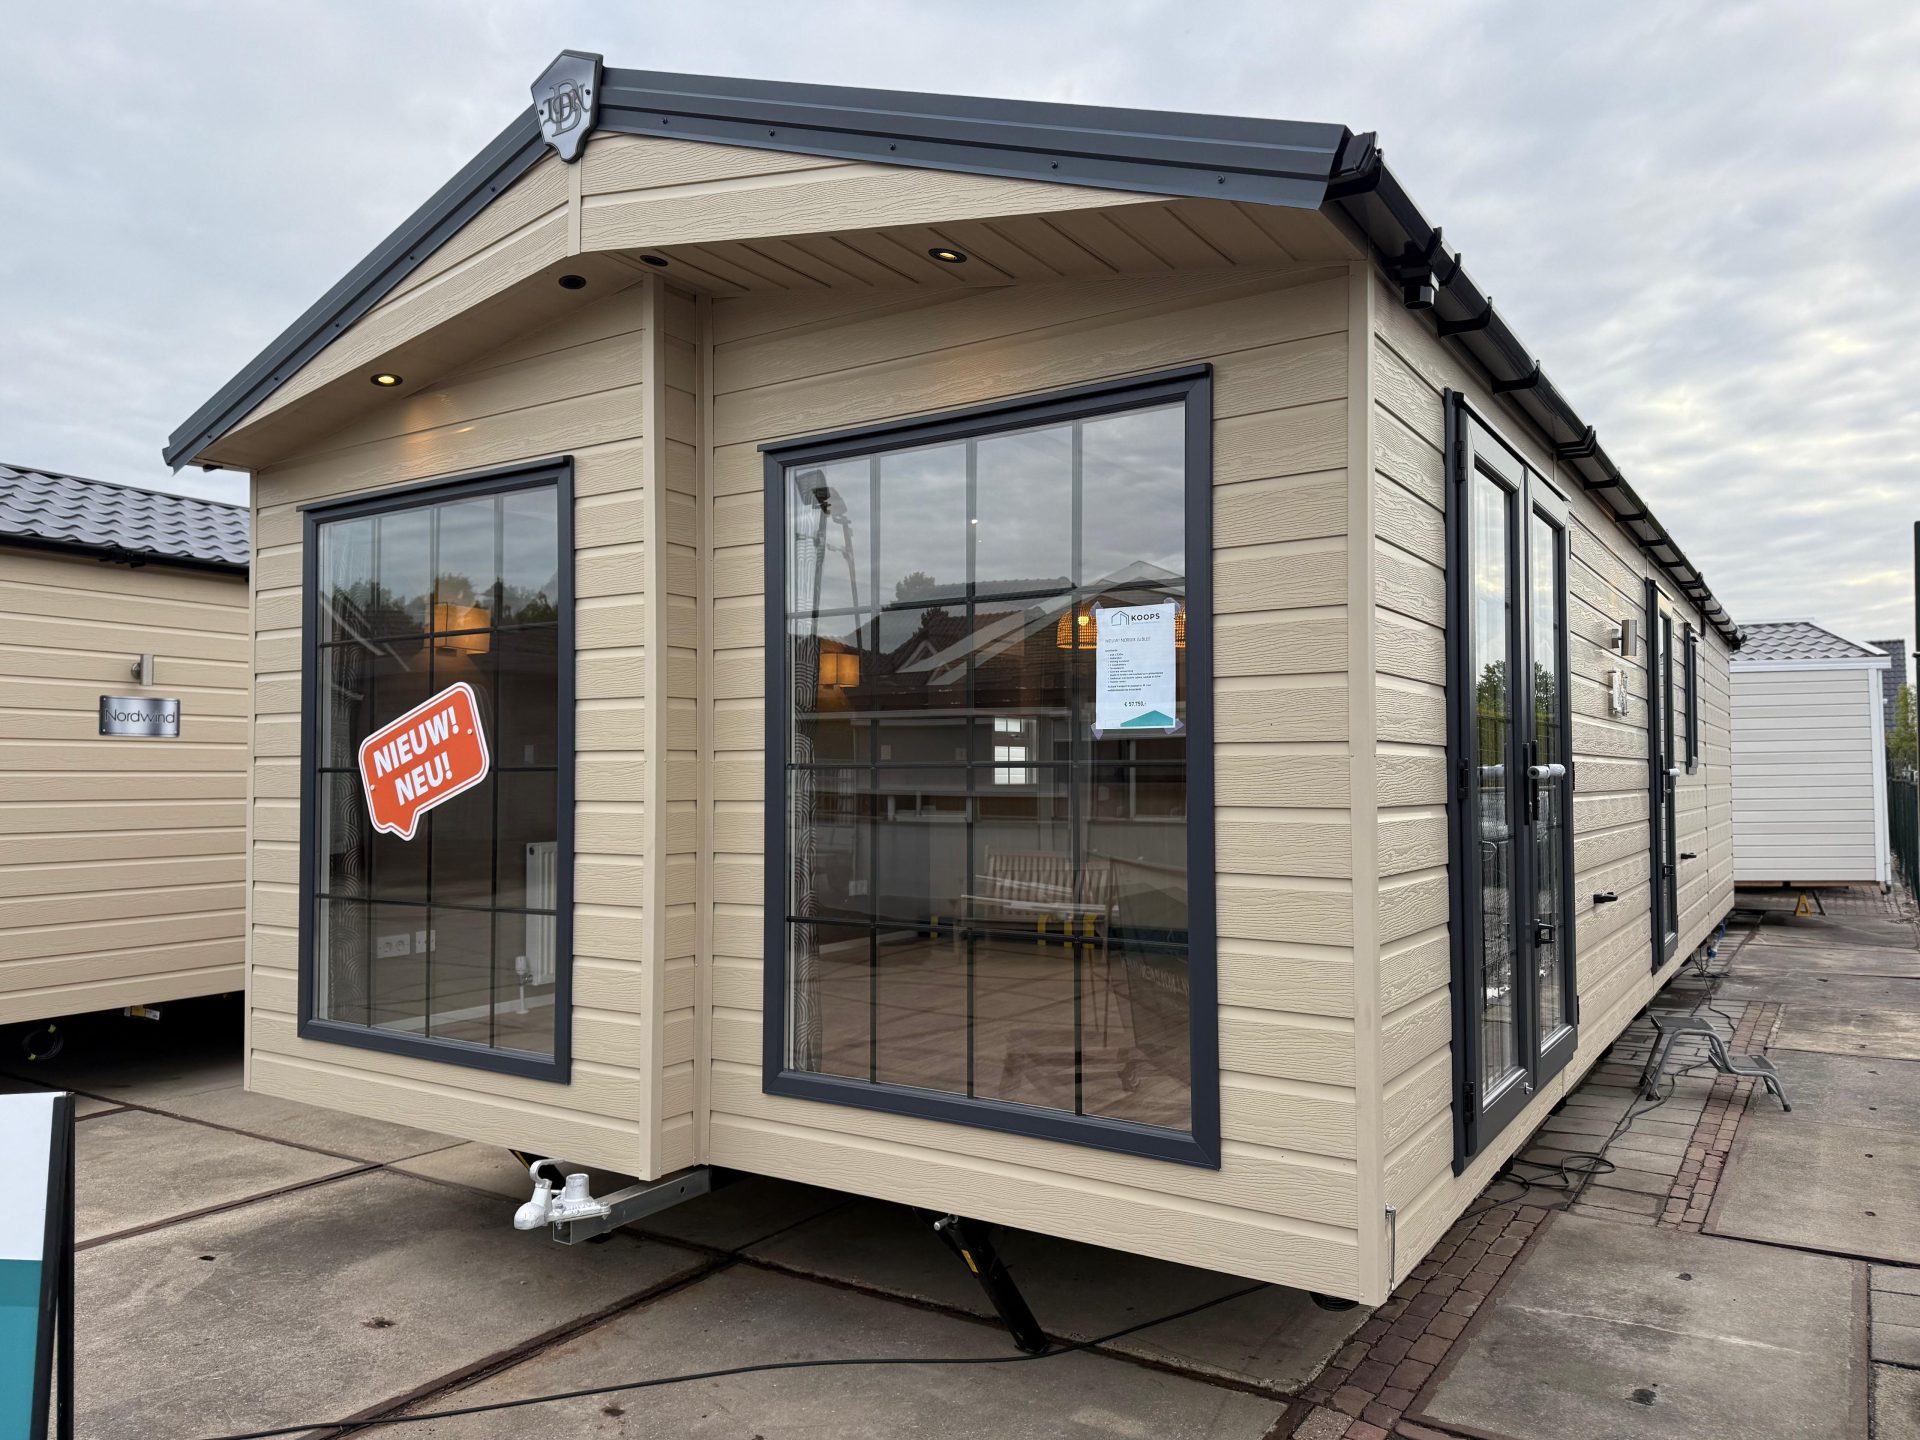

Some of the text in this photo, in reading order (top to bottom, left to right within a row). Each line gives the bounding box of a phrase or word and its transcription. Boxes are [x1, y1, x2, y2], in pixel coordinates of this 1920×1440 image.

[1131, 613, 1160, 621] KOOPS
[104, 708, 176, 724] Nordwind
[373, 706, 460, 779] NIEUW!
[394, 751, 453, 806] NEU!
